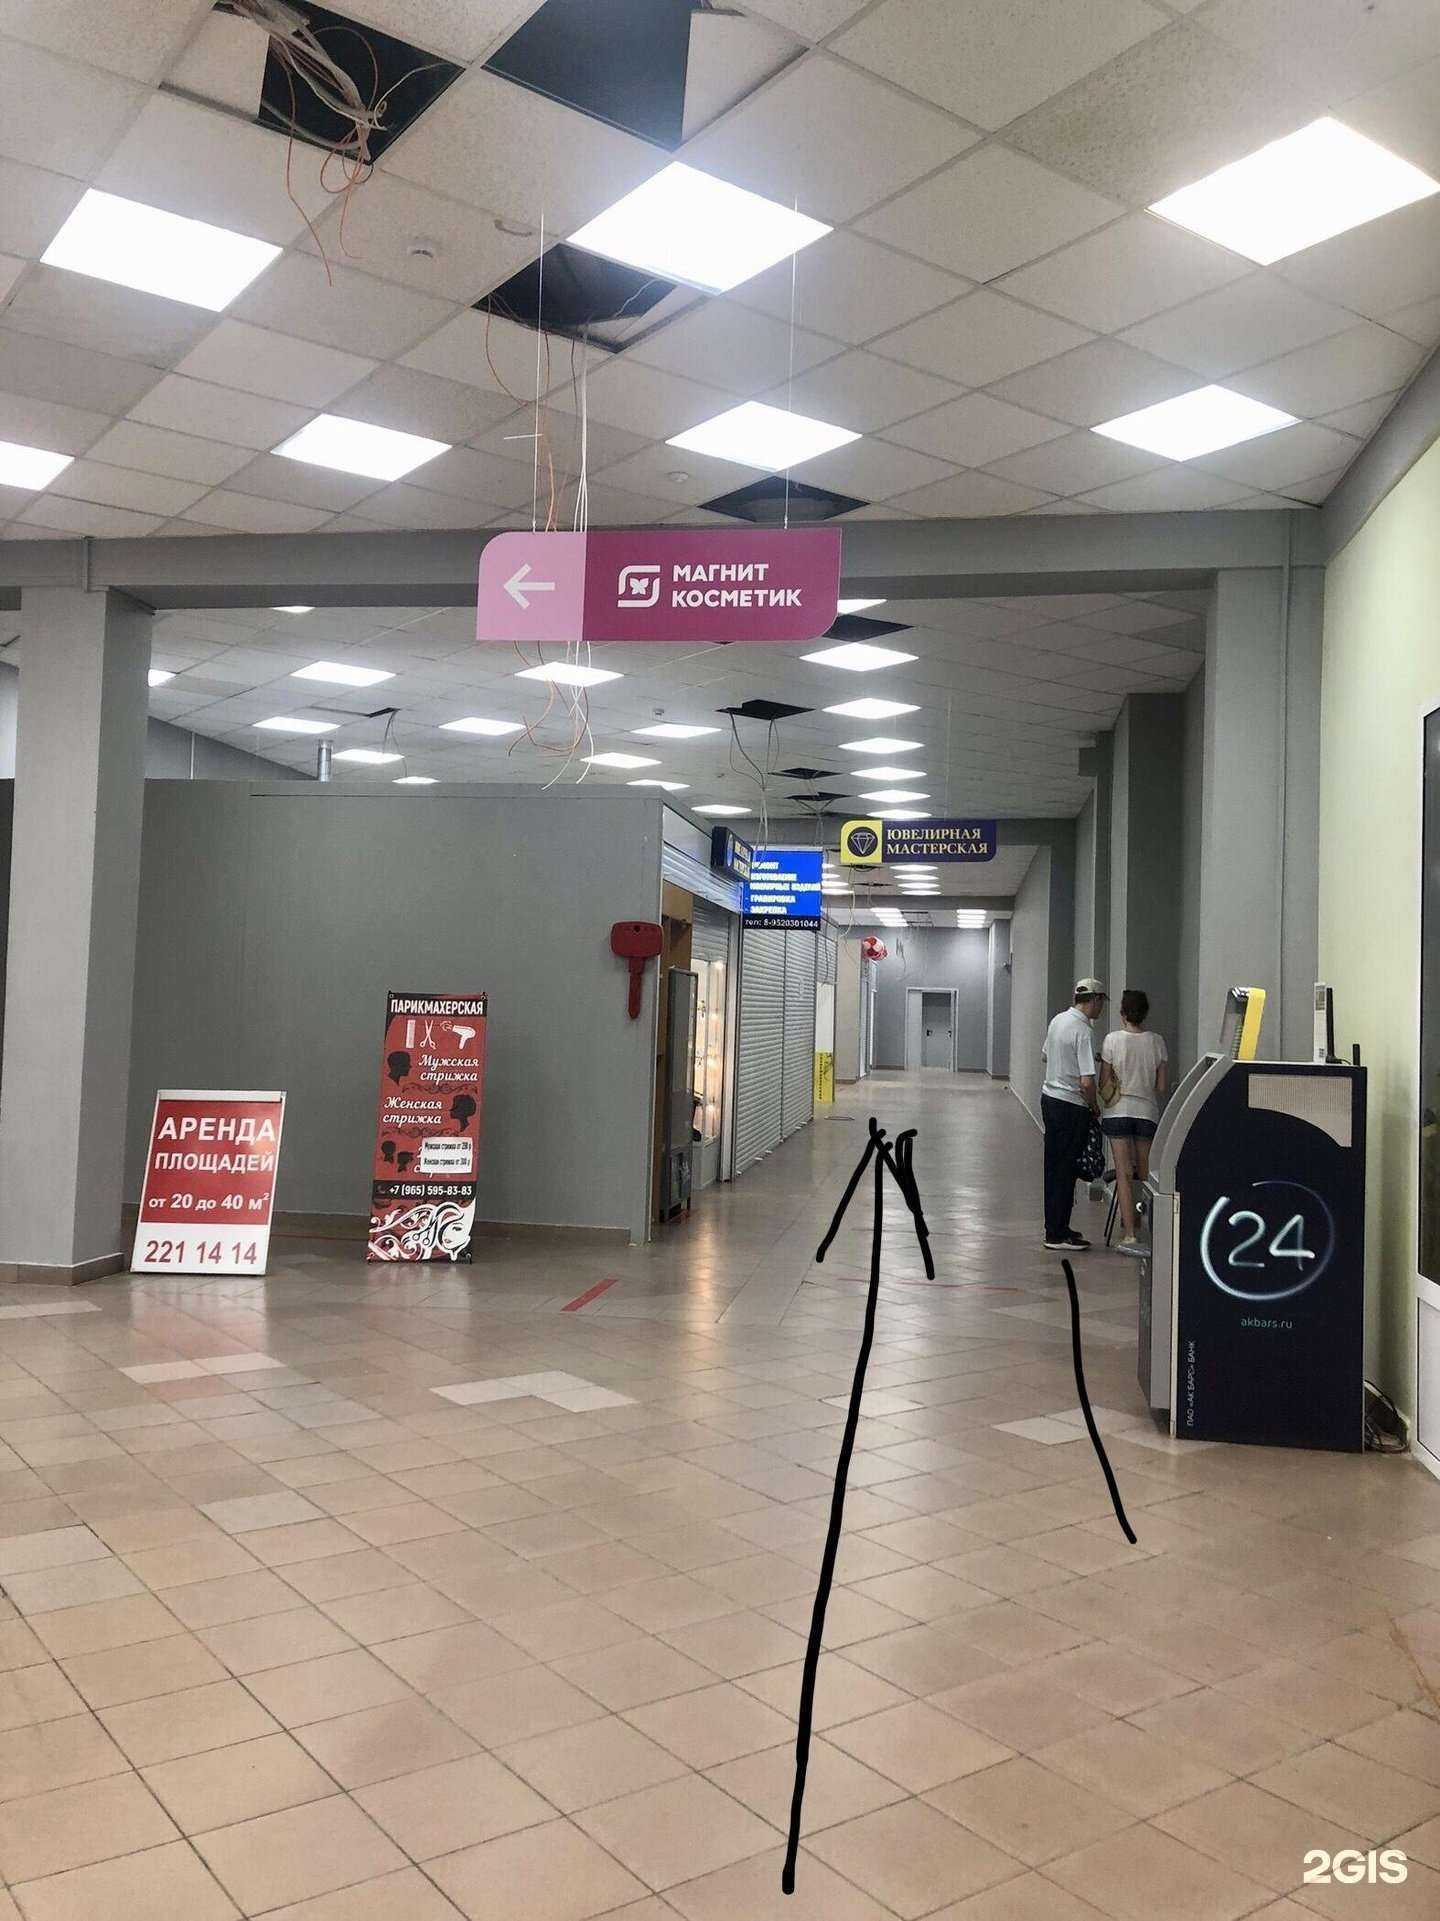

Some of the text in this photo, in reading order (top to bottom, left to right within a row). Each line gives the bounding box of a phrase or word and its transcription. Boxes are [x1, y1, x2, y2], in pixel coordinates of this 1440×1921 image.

[672, 563, 769, 582] МАГНИТ
[672, 589, 802, 608] КОСМЕТИК
[887, 828, 982, 841] ЮВЕЛИРНАЯ
[886, 842, 988, 855] МАСТЕРСКАЯ
[390, 998, 484, 1015] ПАРИКМАХЕРСКАЯ
[418, 1055, 480, 1073] Мужская
[420, 1072, 478, 1086] стрижка
[384, 1096, 443, 1111] Женская
[383, 1112, 442, 1128] стрижка
[157, 1116, 276, 1145] АРЕНДА
[154, 1151, 274, 1174] ПЛОЩАДЕЙ
[389, 1184, 473, 1198] +7 (965) 595-83-83
[148, 1197, 166, 1209] от
[170, 1193, 193, 1209] 20
[195, 1198, 217, 1211] до
[220, 1194, 244, 1210] 40
[1228, 1210, 1316, 1272] 24
[144, 1240, 257, 1265] 221 14 14
[1240, 1317, 1293, 1329] akbars.ru
